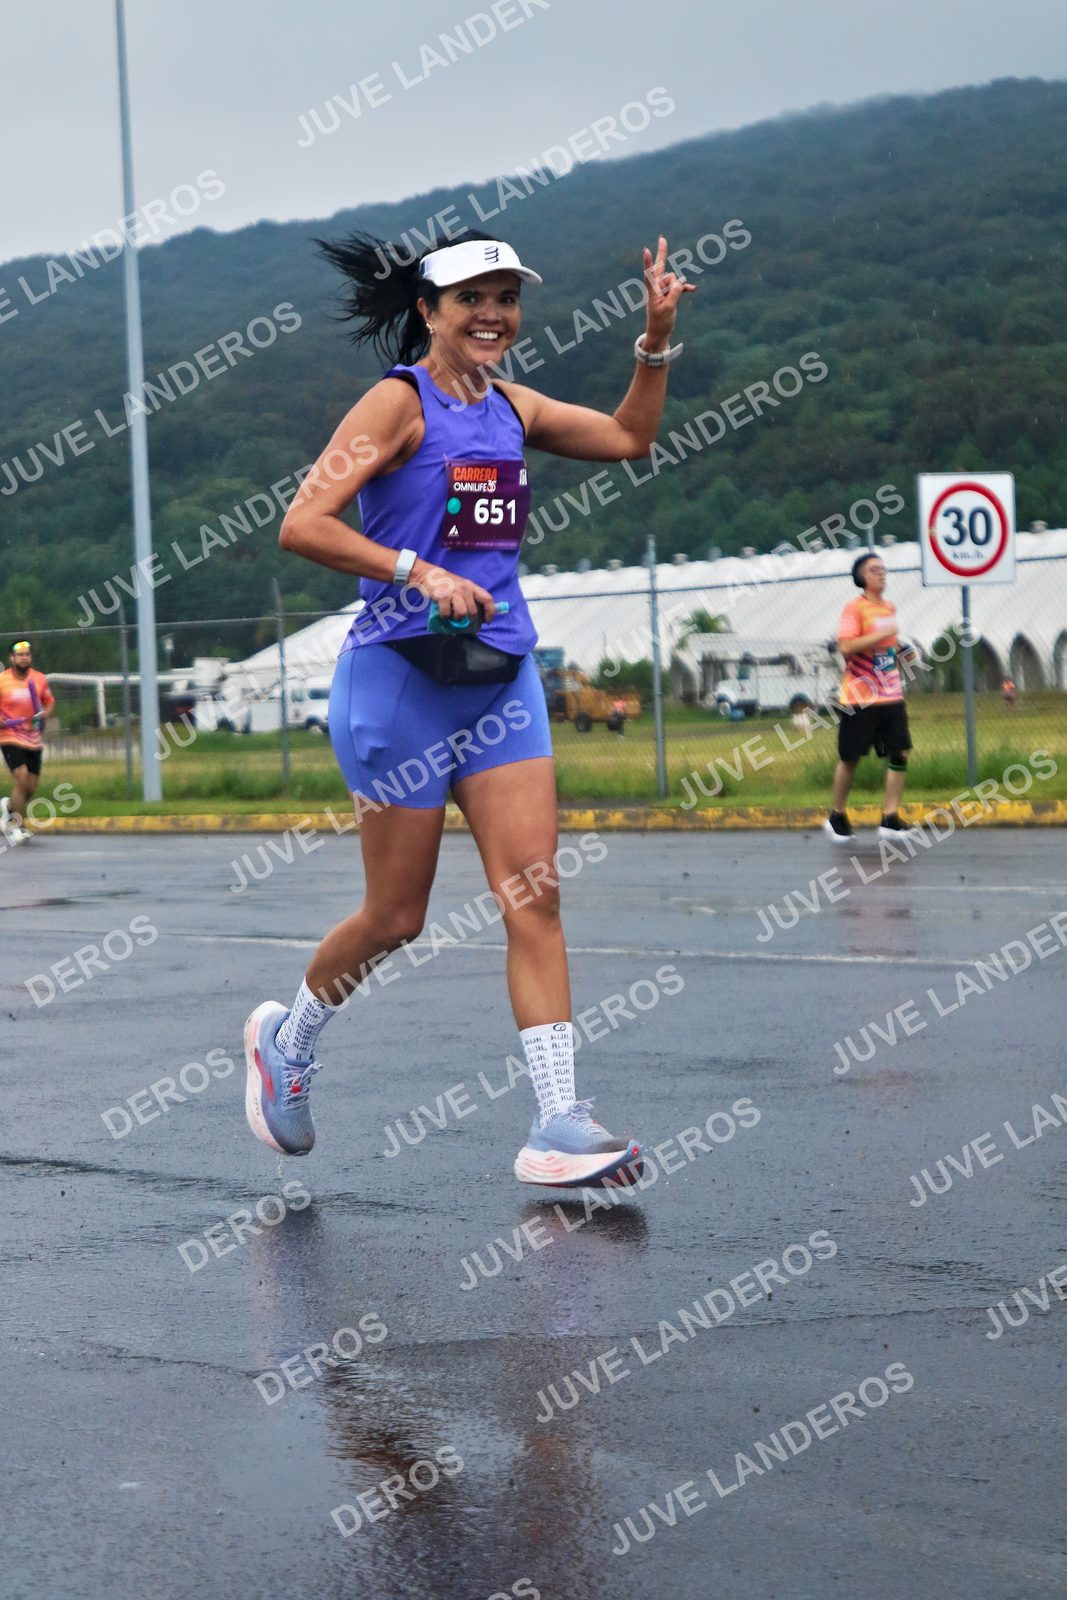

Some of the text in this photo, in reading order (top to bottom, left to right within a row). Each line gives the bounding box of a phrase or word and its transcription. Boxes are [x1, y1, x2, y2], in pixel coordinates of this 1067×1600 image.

[453, 466, 498, 481] CARRERA
[453, 482, 487, 492] OMNILIFE
[474, 498, 516, 525] 651
[943, 506, 993, 546] 30
